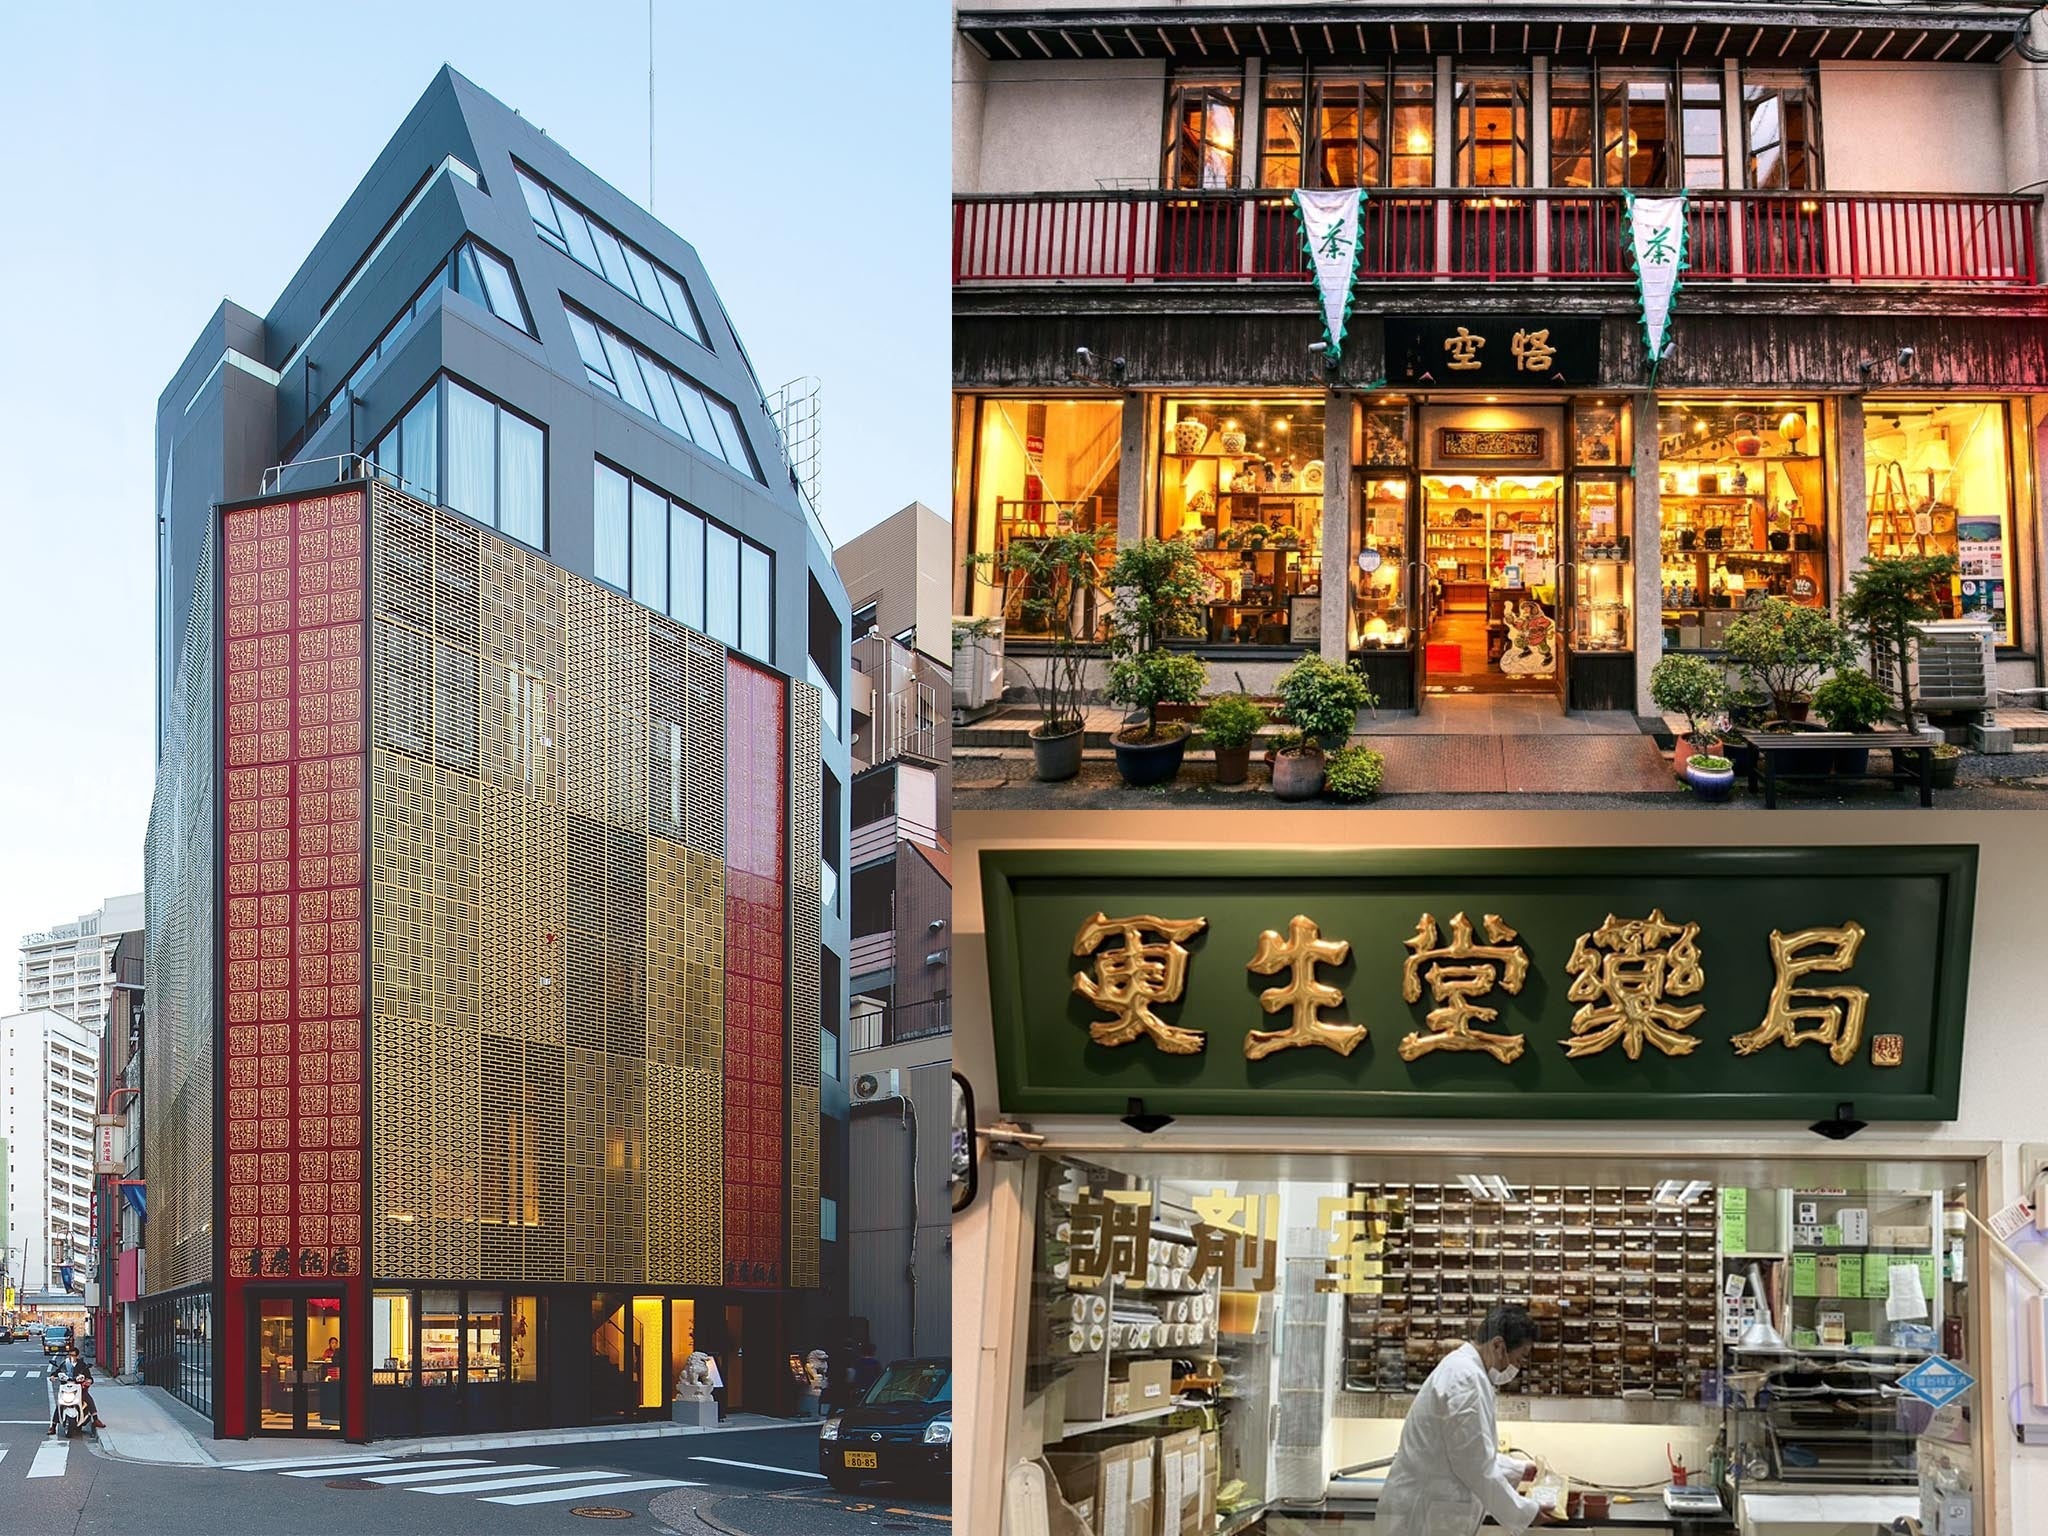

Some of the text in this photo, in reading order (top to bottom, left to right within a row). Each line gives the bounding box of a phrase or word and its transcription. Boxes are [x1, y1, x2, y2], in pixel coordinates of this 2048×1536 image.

[1318, 218, 1353, 260] 茶
[1643, 226, 1677, 266] 茶
[851, 1458, 876, 1467] 80-85
